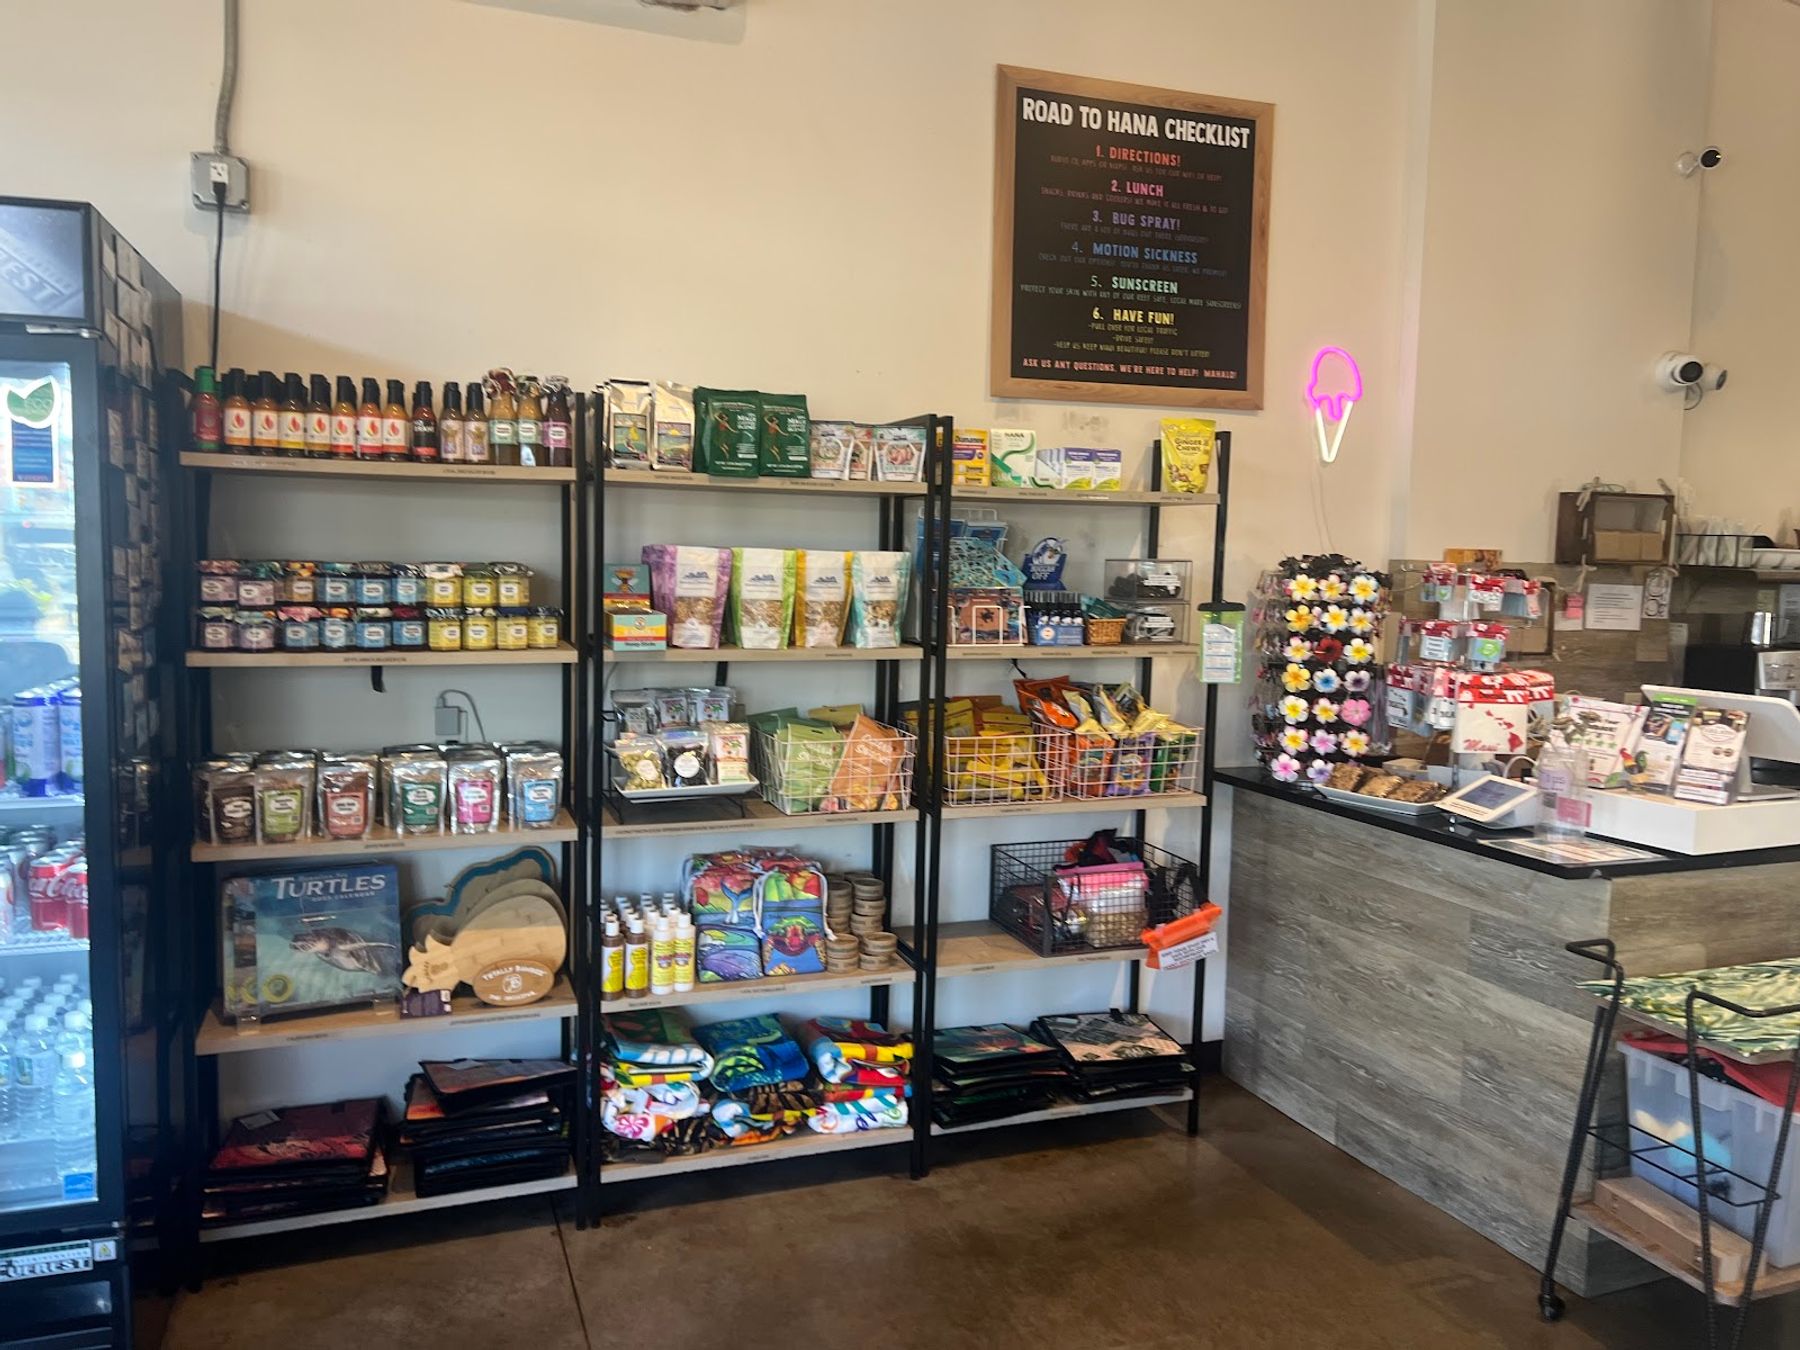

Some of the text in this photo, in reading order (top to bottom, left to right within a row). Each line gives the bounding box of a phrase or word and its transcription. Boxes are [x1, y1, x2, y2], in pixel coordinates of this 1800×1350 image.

[1022, 97, 1251, 149] ROAD TO HANA CHECKLIST
[1095, 144, 1181, 167] 1. DIRECTIONS!
[1111, 179, 1164, 197] 2. LUNCH
[1092, 210, 1181, 231] 3. BUG SPRAY!
[1071, 240, 1198, 265] 4. MOTION SICKNESS
[1090, 275, 1178, 294] 5. SUNSCREEN
[1092, 306, 1175, 326] 6. HAVE FUN!
[1022, 357, 1038, 367] ASK
[1040, 359, 1052, 368] US
[1054, 360, 1071, 369] ANY
[1145, 365, 1164, 375] HERE
[1166, 367, 1176, 376] TO
[1178, 367, 1199, 377] HELP!
[1175, 438, 1202, 446] GINGER
[271, 874, 387, 900] TURTLES
[481, 966, 514, 981] TOTALLY
